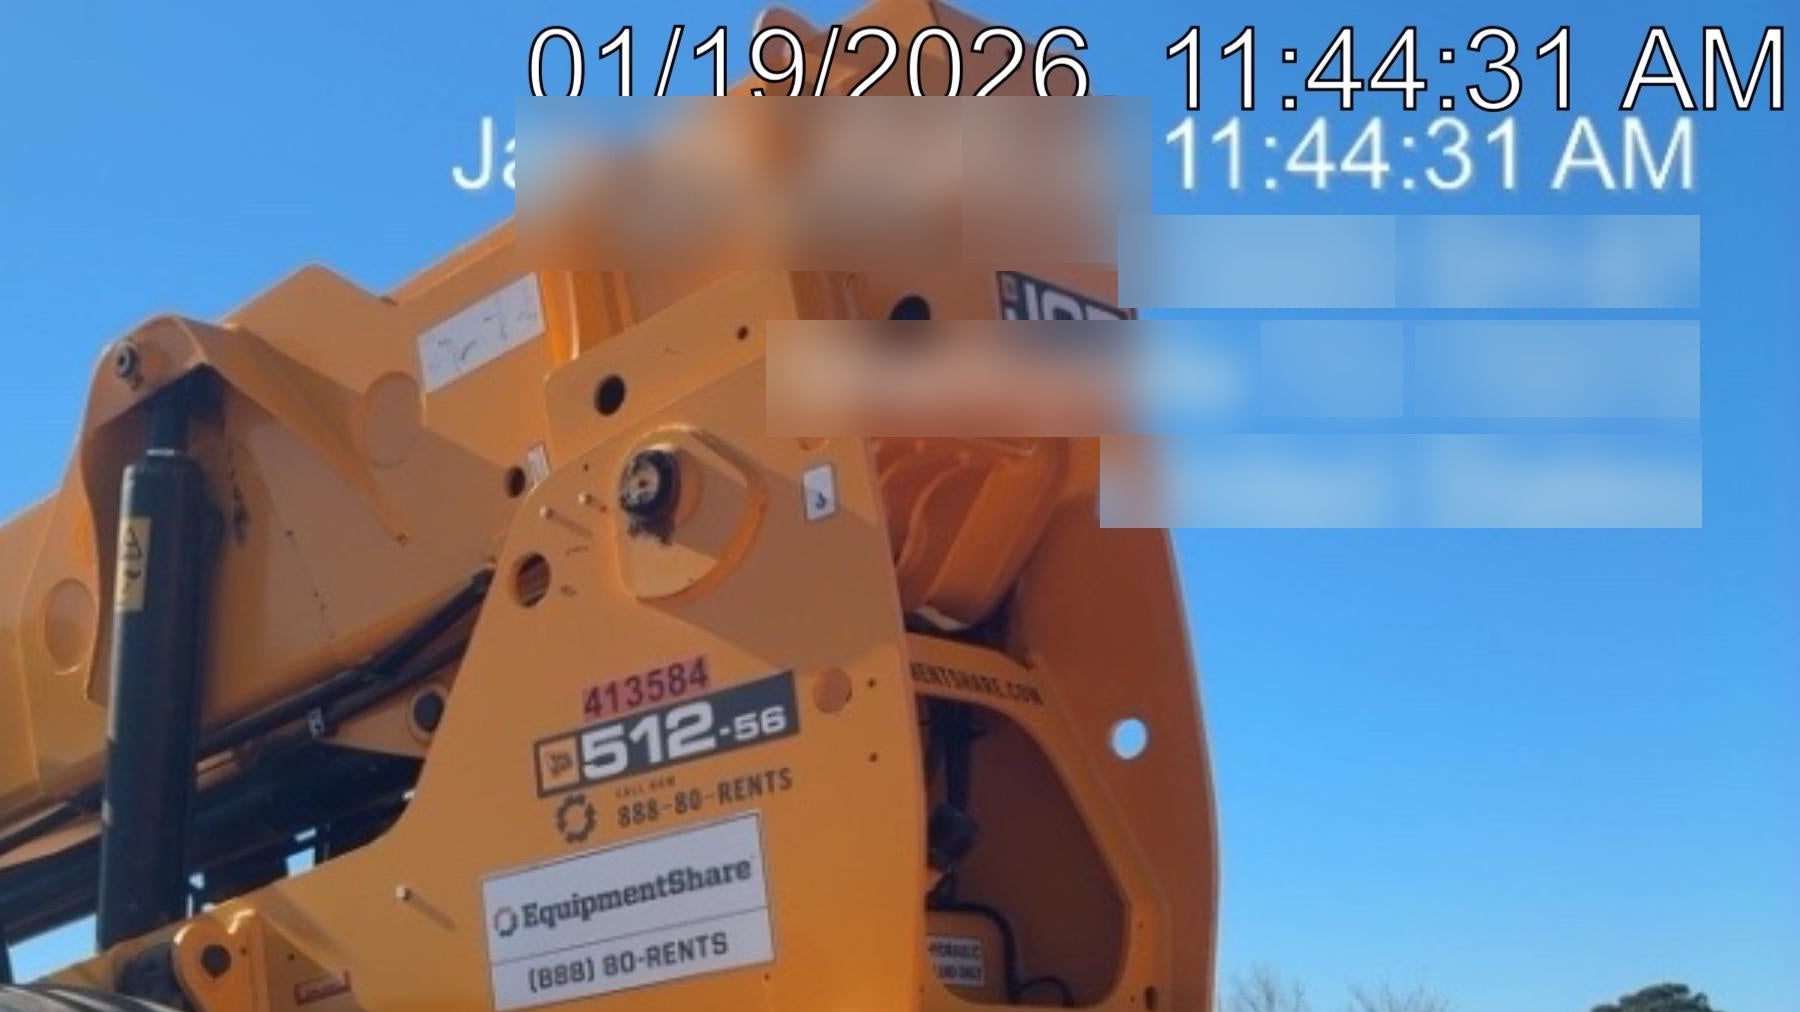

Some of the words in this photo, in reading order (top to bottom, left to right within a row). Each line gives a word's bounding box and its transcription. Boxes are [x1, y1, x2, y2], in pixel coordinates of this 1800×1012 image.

[583, 655, 709, 716] 413584
[617, 767, 793, 828] 888-80-RENTS
[520, 859, 752, 928] EquipmentShare
[528, 957, 595, 993] (888)
[603, 932, 729, 976] 80-RENTS
